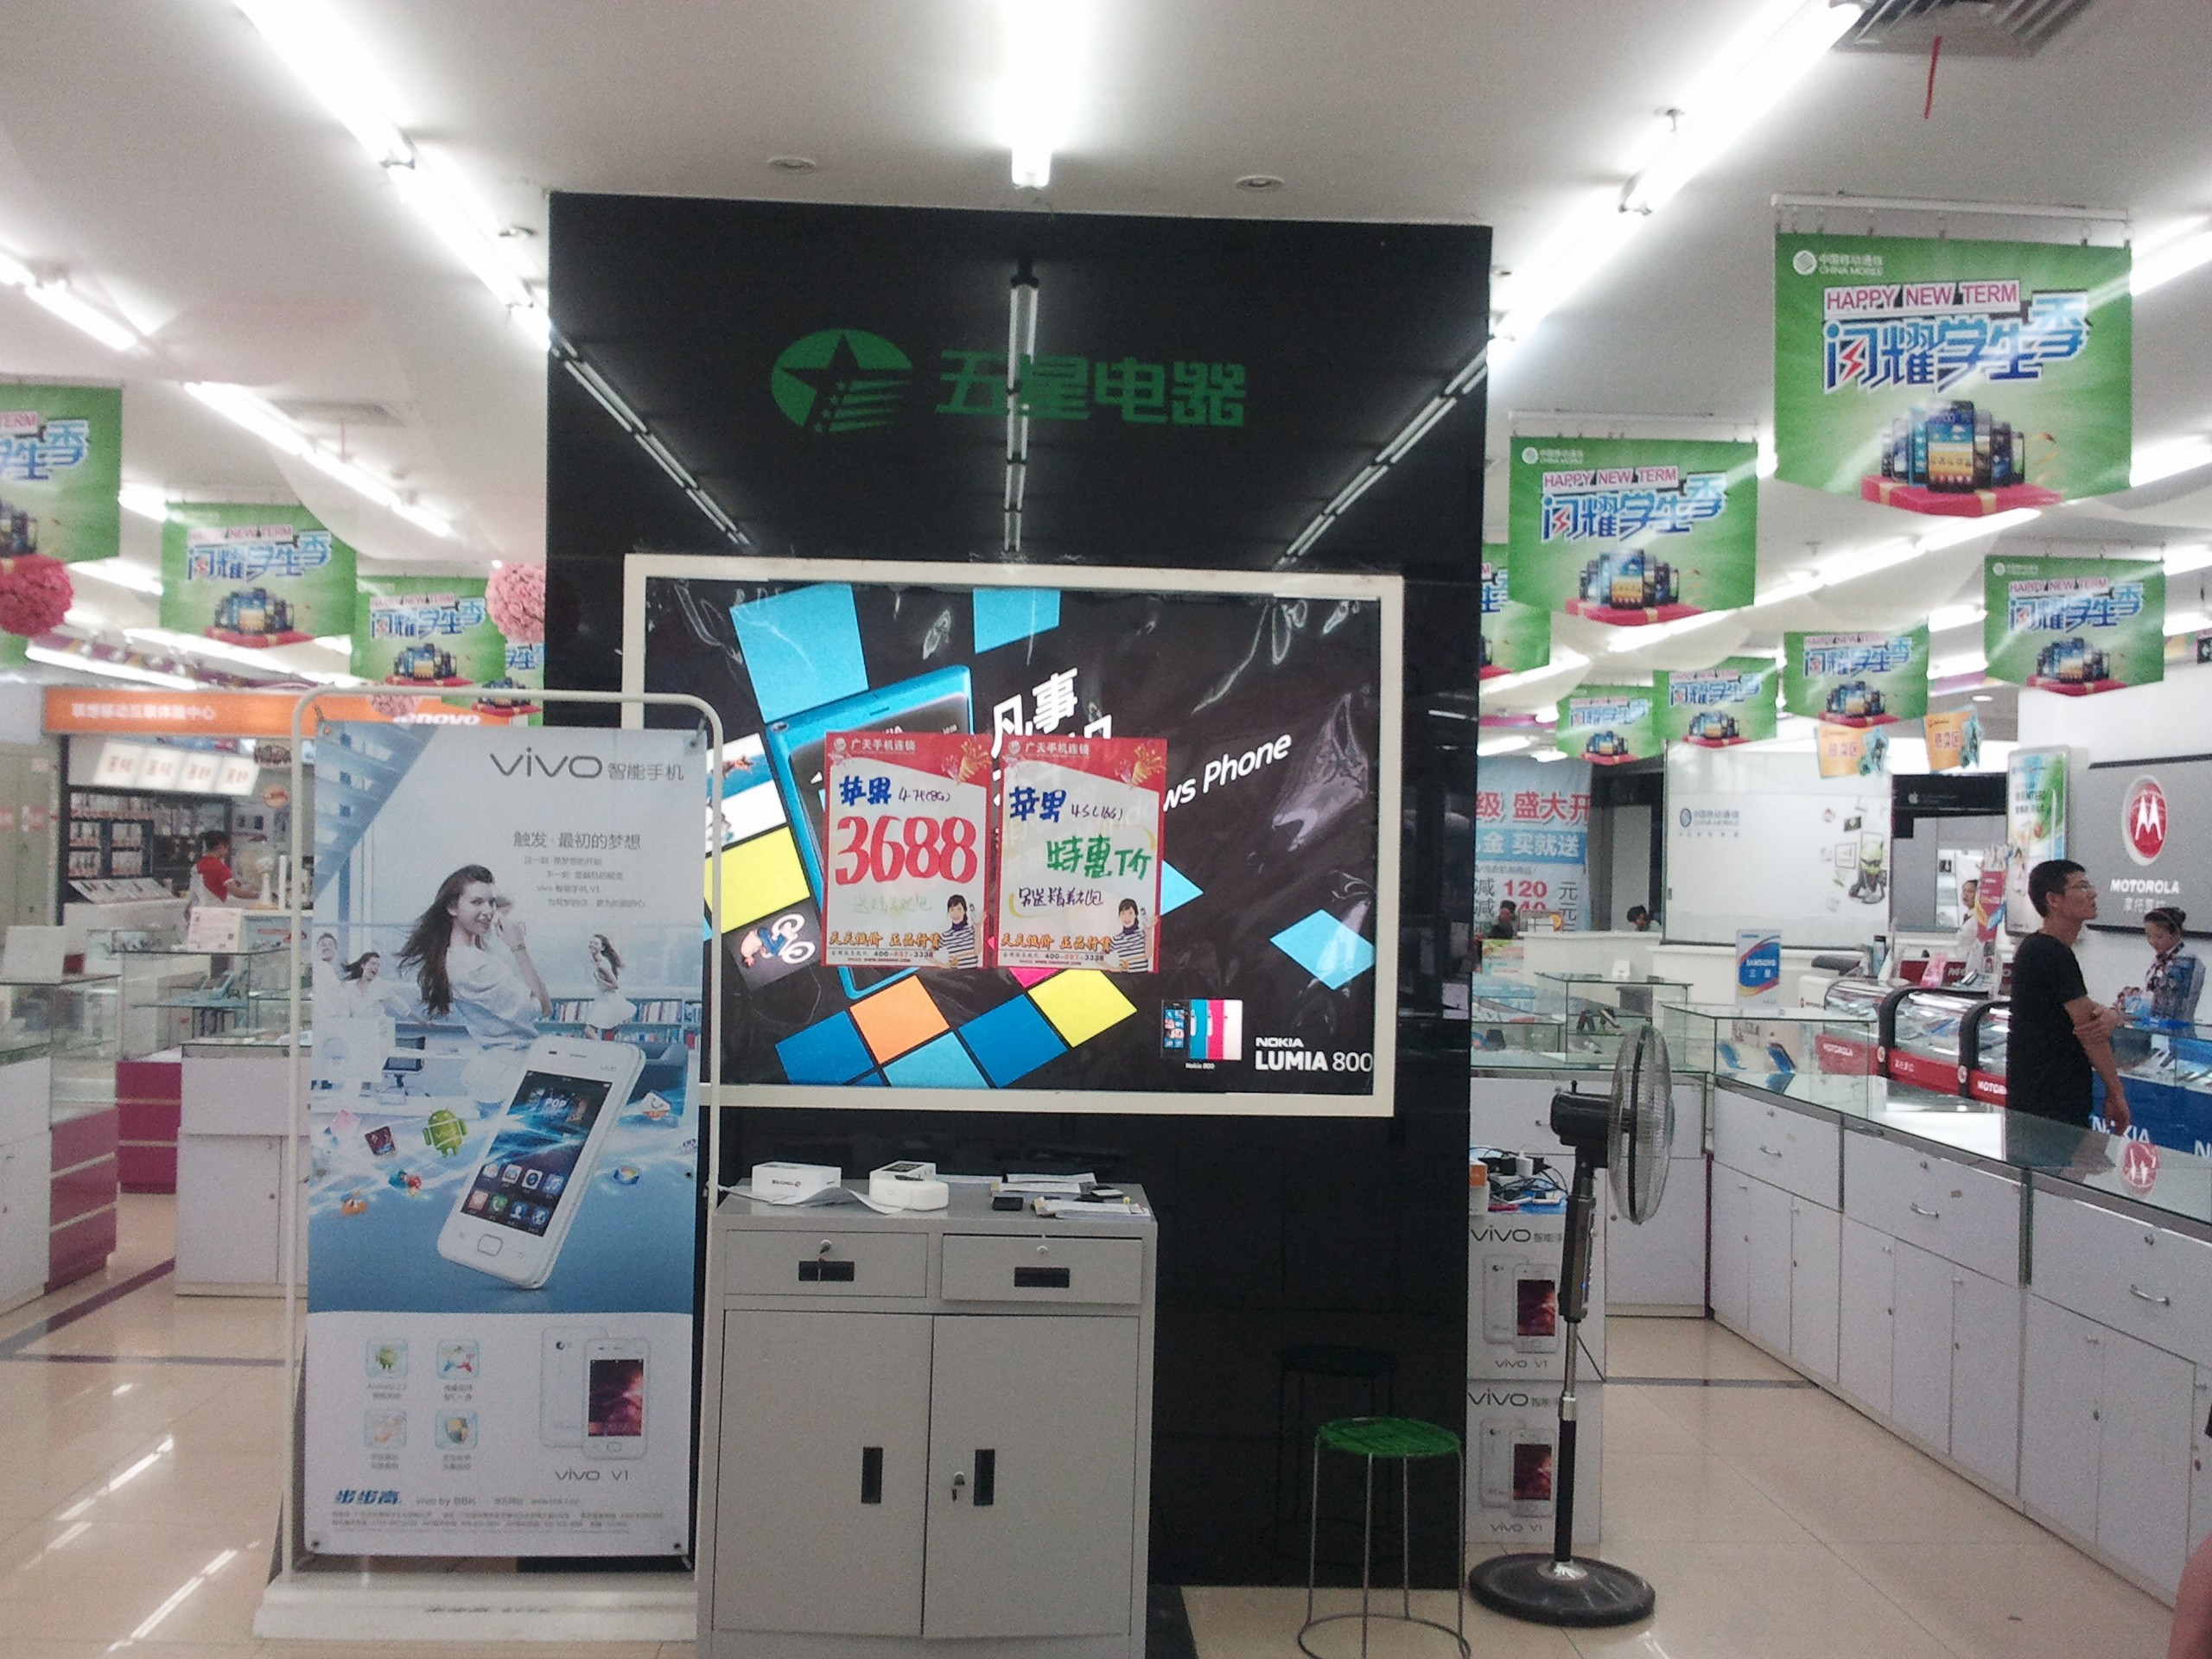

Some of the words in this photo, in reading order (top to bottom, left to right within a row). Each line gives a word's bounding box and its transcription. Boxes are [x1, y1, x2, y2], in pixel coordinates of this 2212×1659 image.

[1827, 289, 1895, 309] HAPPY
[1906, 286, 1955, 306] NEW
[1961, 283, 2019, 304] TERM
[1823, 291, 2091, 394] 闪耀学生季
[935, 349, 1246, 426] 五星电器
[1544, 472, 1593, 488] HAPPY
[1598, 469, 1632, 483] NEW
[1639, 467, 1677, 481] TERM
[1542, 474, 1726, 541] 闪耀学生季
[991, 668, 1077, 759] 凡事
[490, 747, 603, 778] vivo
[608, 762, 684, 781] 智能手机
[1203, 734, 1292, 793] Phone
[839, 775, 892, 806] 苹果
[835, 815, 978, 886] 3688
[1046, 834, 1152, 880] 特惠价
[1513, 832, 1580, 857] 买就送
[1504, 879, 1548, 898] 120
[1559, 881, 1579, 900] 元
[2109, 879, 2180, 894] MOTOROLA
[1255, 1037, 1305, 1047] NOKIA
[1255, 1050, 1329, 1071] LUMIA
[1332, 1052, 1373, 1072] 800
[545, 1097, 568, 1109] POP
[1471, 1224, 1531, 1243] vivo
[1496, 1359, 1528, 1368] vivo
[1535, 1359, 1548, 1368] V1
[1468, 1388, 1529, 1408] vivo
[555, 1468, 601, 1481] vivo
[612, 1470, 628, 1481] V1
